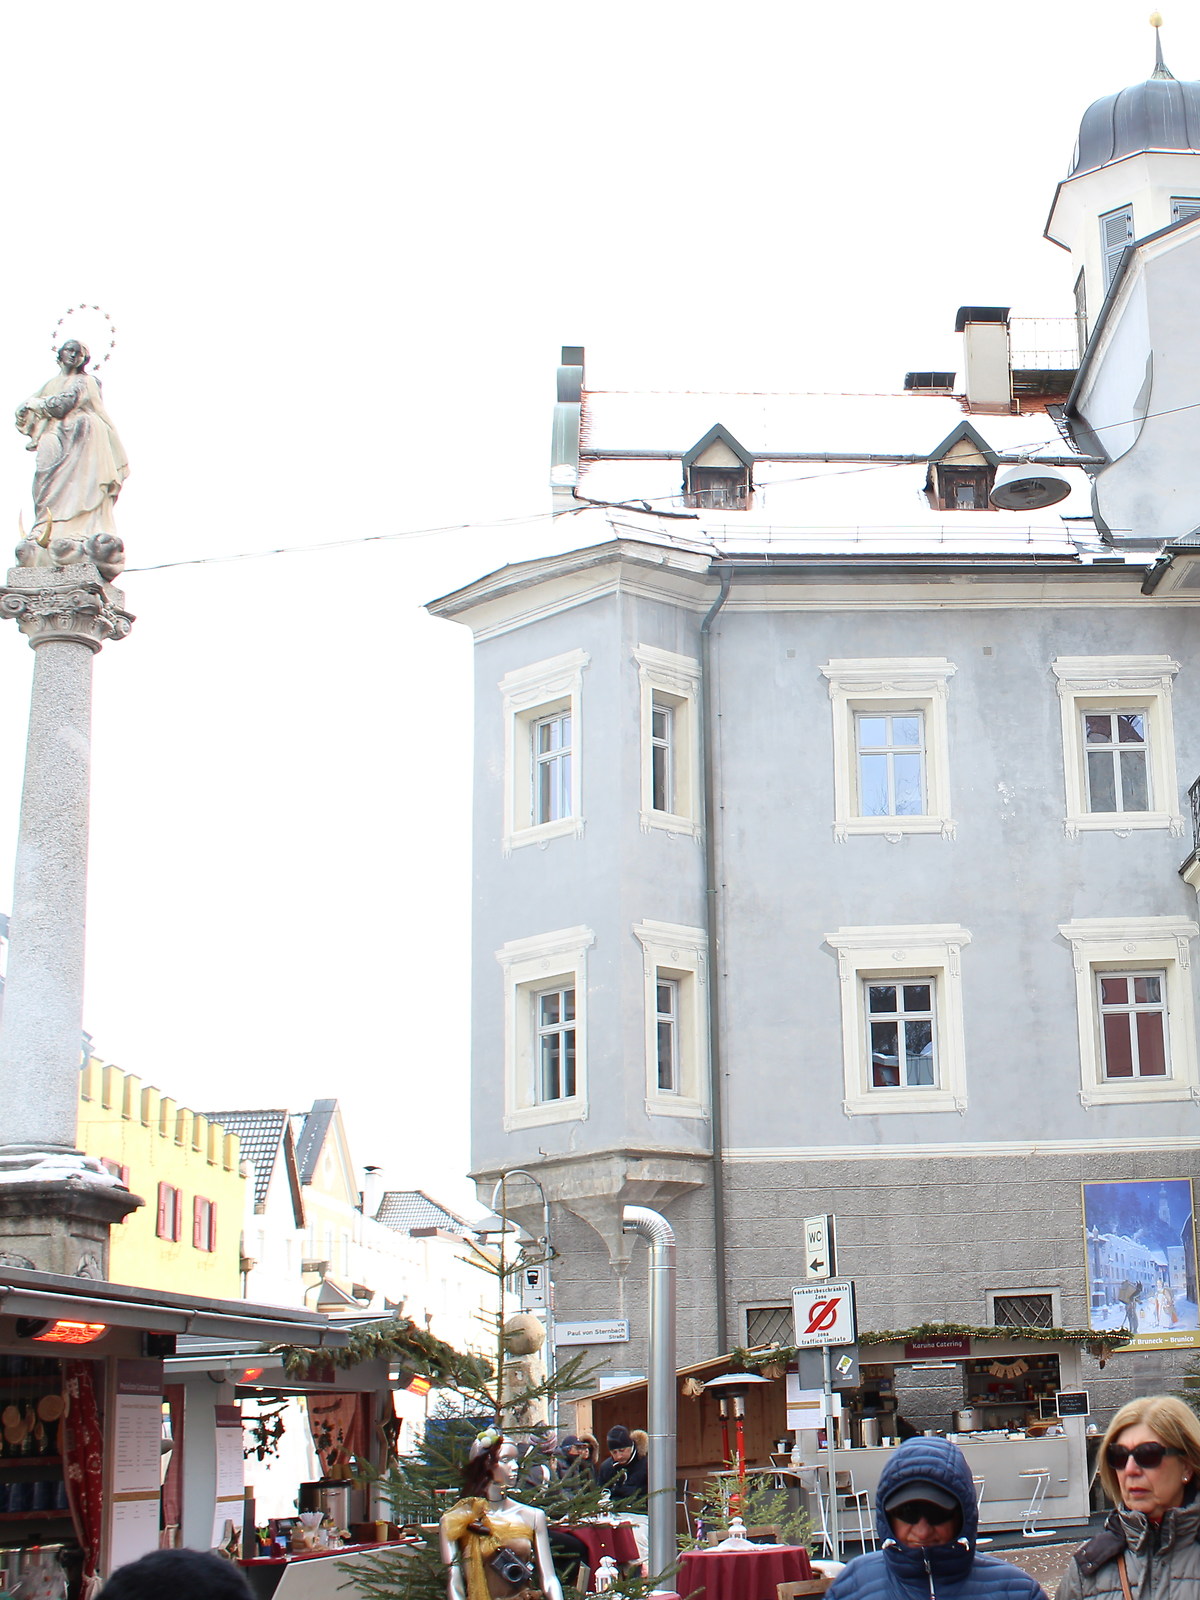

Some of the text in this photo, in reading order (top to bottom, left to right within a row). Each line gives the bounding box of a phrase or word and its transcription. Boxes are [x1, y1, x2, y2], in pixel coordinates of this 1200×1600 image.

[808, 1230, 822, 1243] WC
[935, 1340, 963, 1348] Catering
[1137, 1337, 1163, 1345] Bruneck
[1170, 1335, 1194, 1343] Brunico
